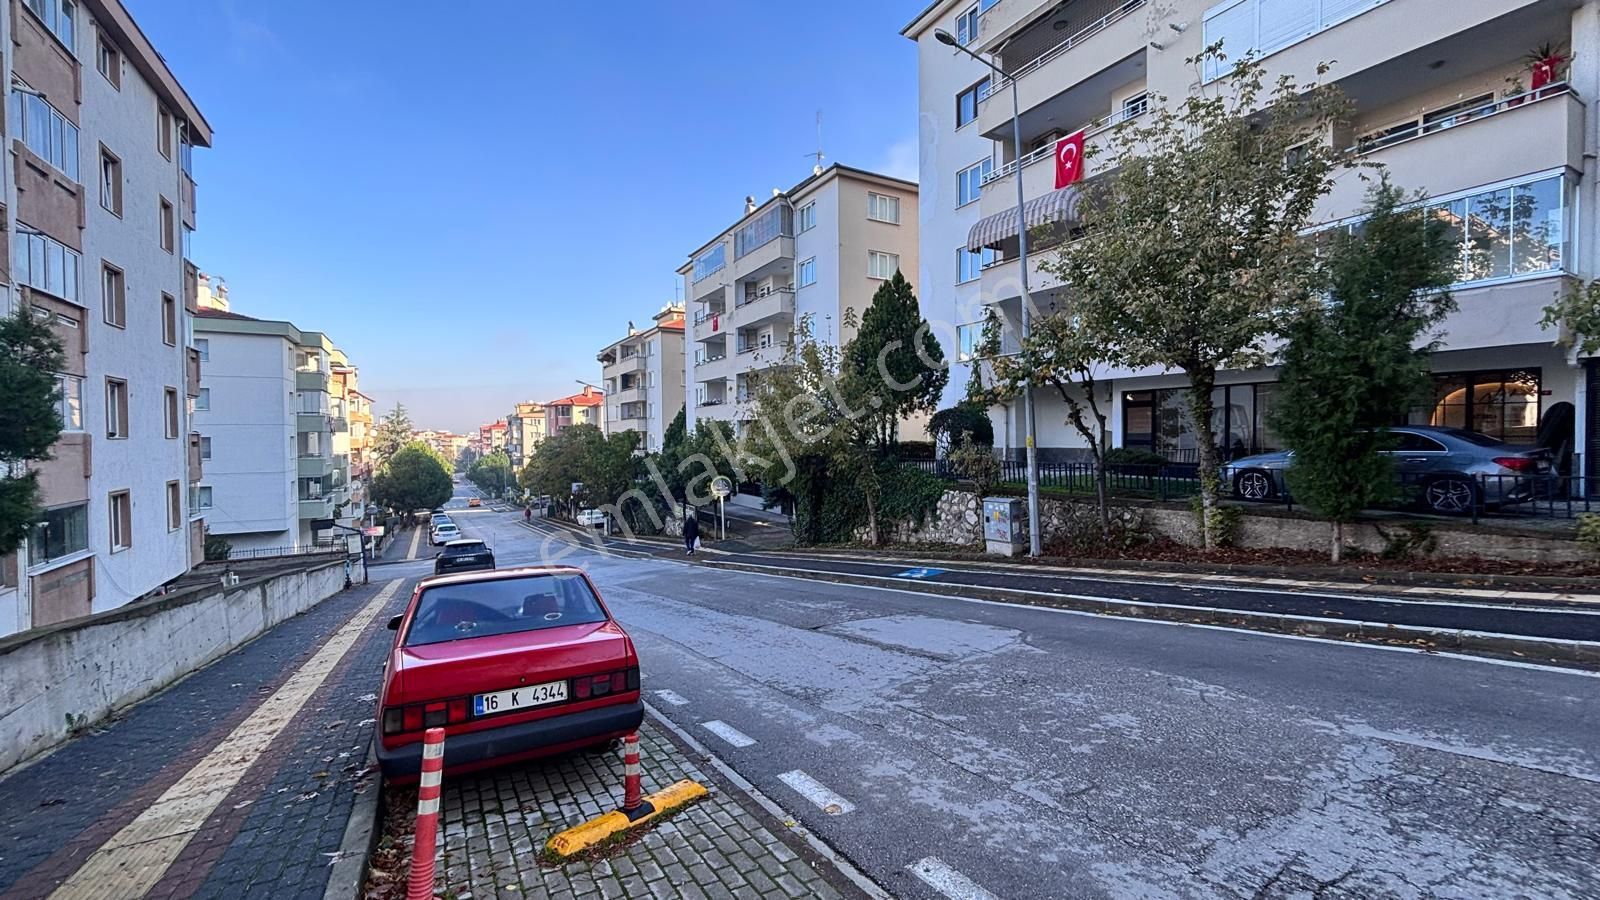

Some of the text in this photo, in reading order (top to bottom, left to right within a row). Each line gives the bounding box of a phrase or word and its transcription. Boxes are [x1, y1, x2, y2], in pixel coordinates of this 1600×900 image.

[485, 683, 564, 711] 16 K 4344
